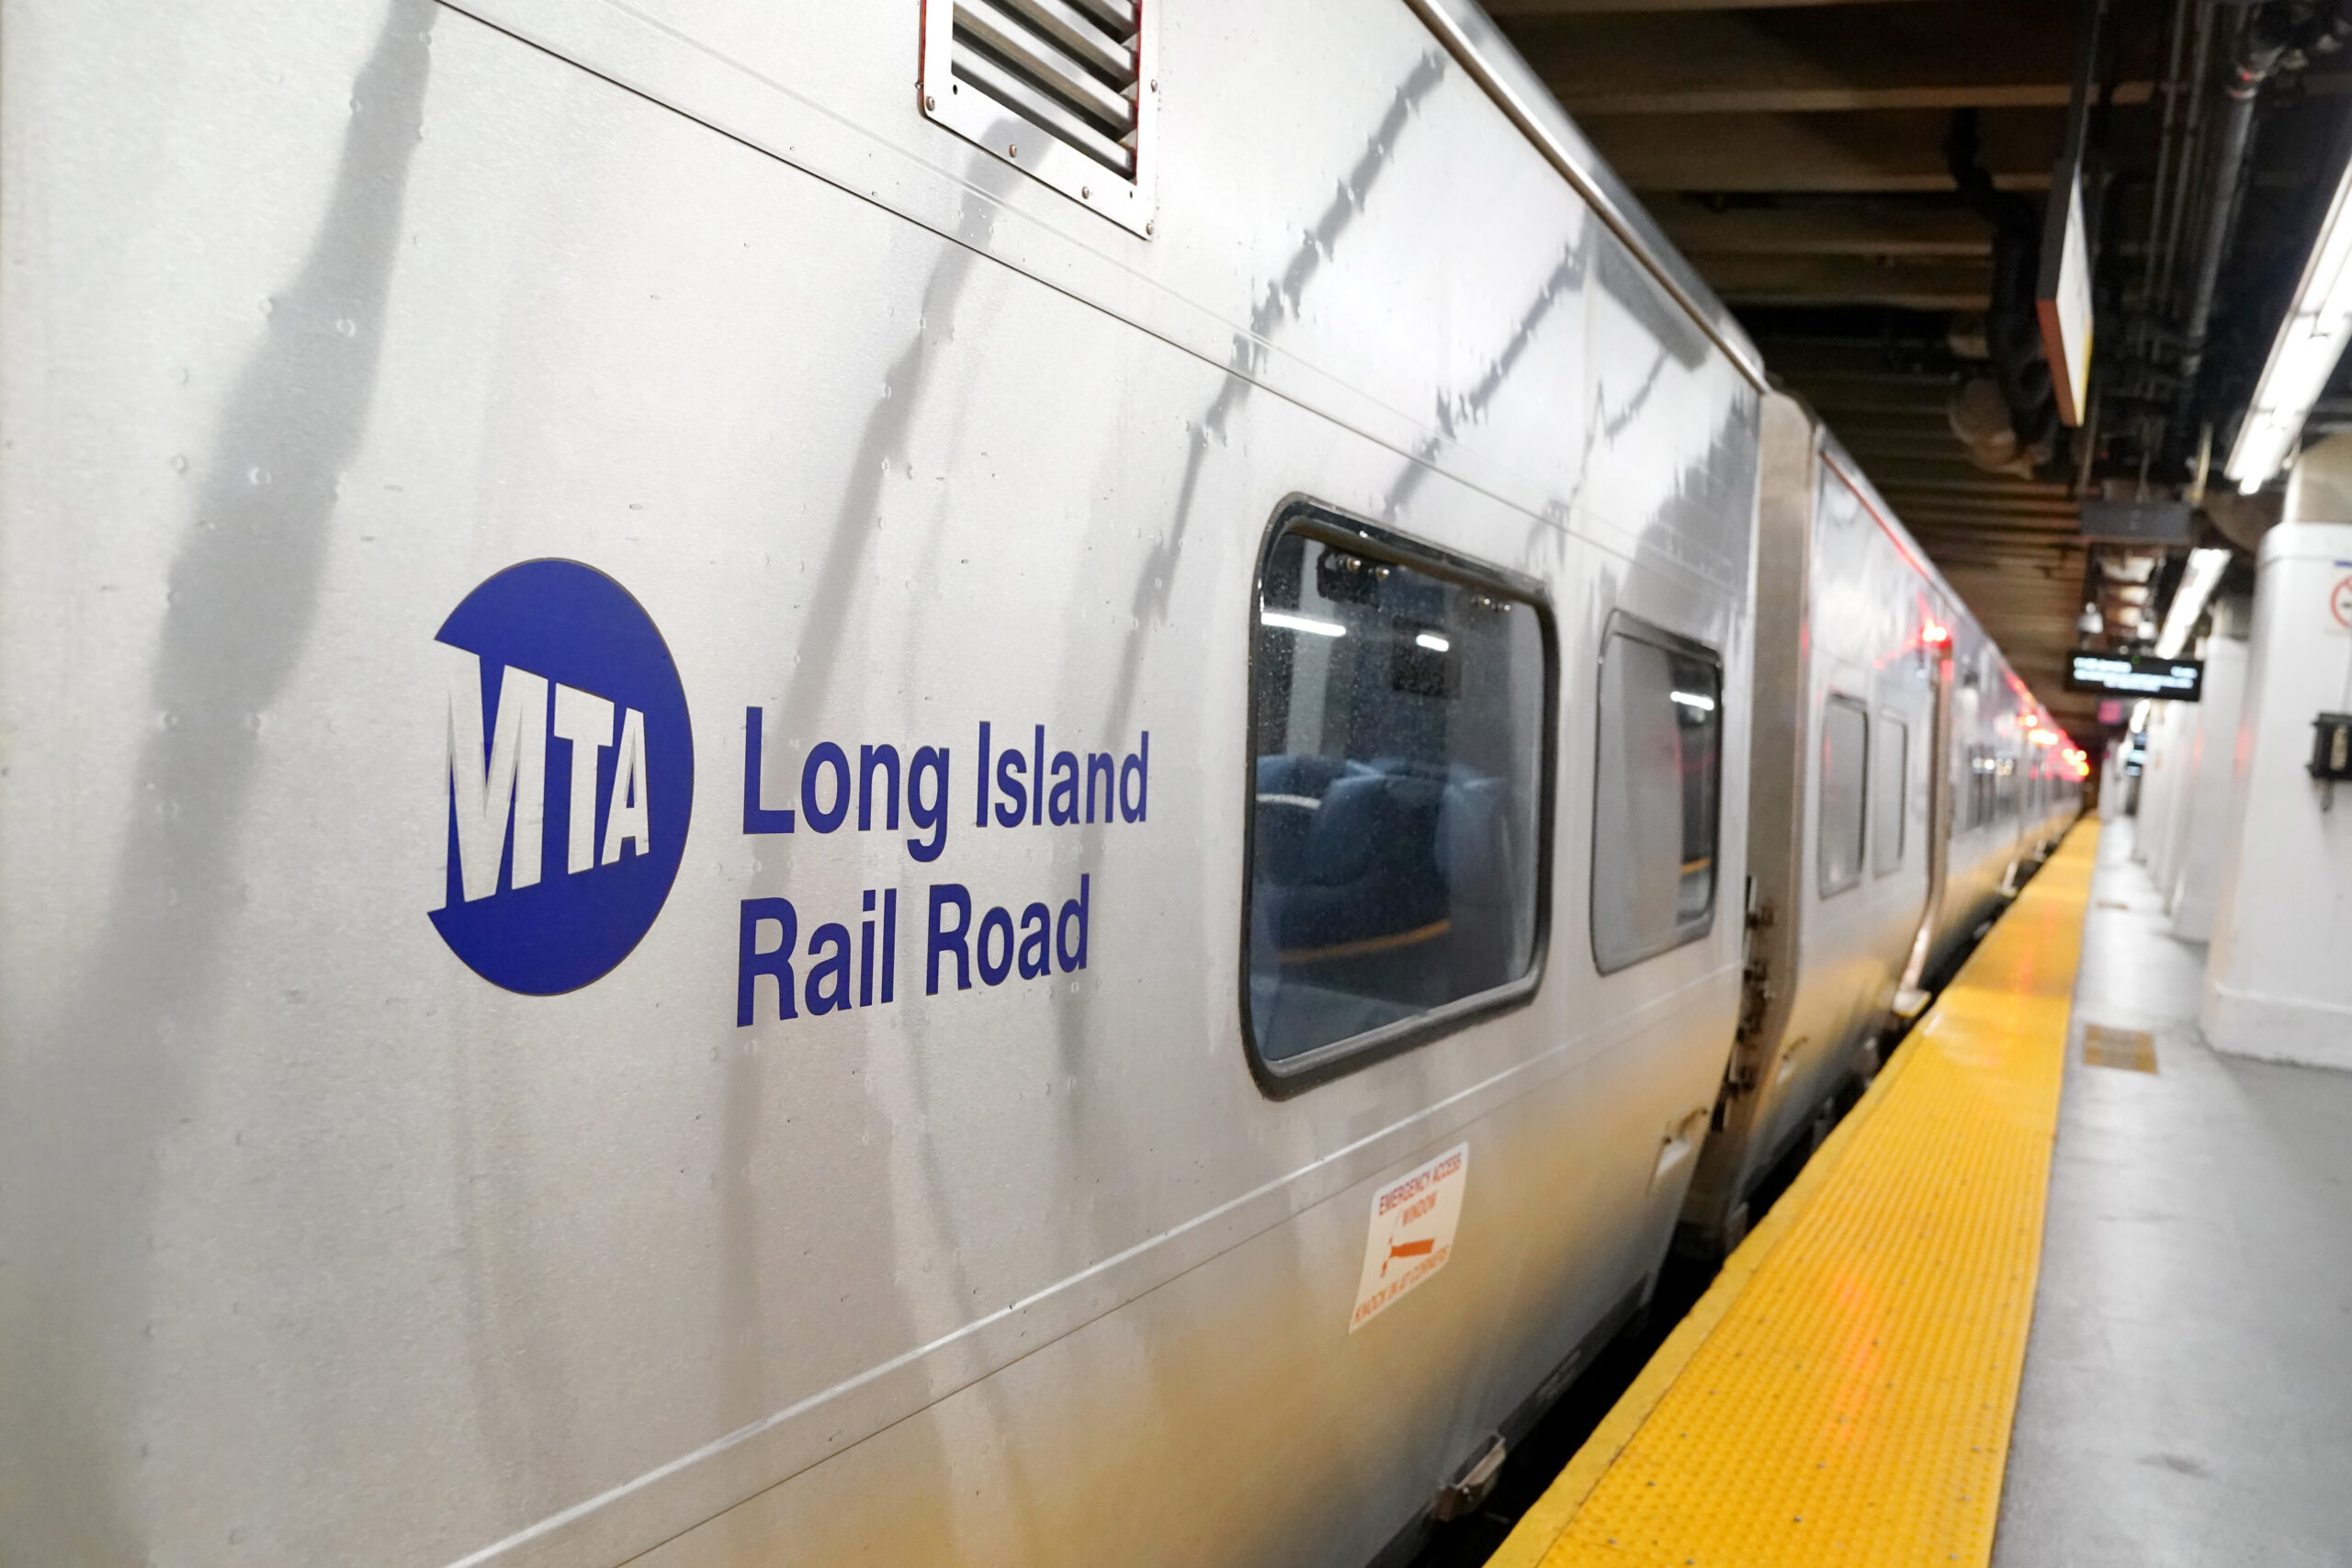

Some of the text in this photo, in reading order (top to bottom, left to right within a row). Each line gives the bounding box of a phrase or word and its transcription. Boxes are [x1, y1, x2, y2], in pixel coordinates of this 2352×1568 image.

[430, 639, 650, 913] MTA
[743, 706, 1149, 863] Long Island
[737, 874, 1091, 1027] Rail Road
[1379, 1152, 1462, 1215] EMERGENCY ACCESS
[1403, 1191, 1437, 1225] WINDOW
